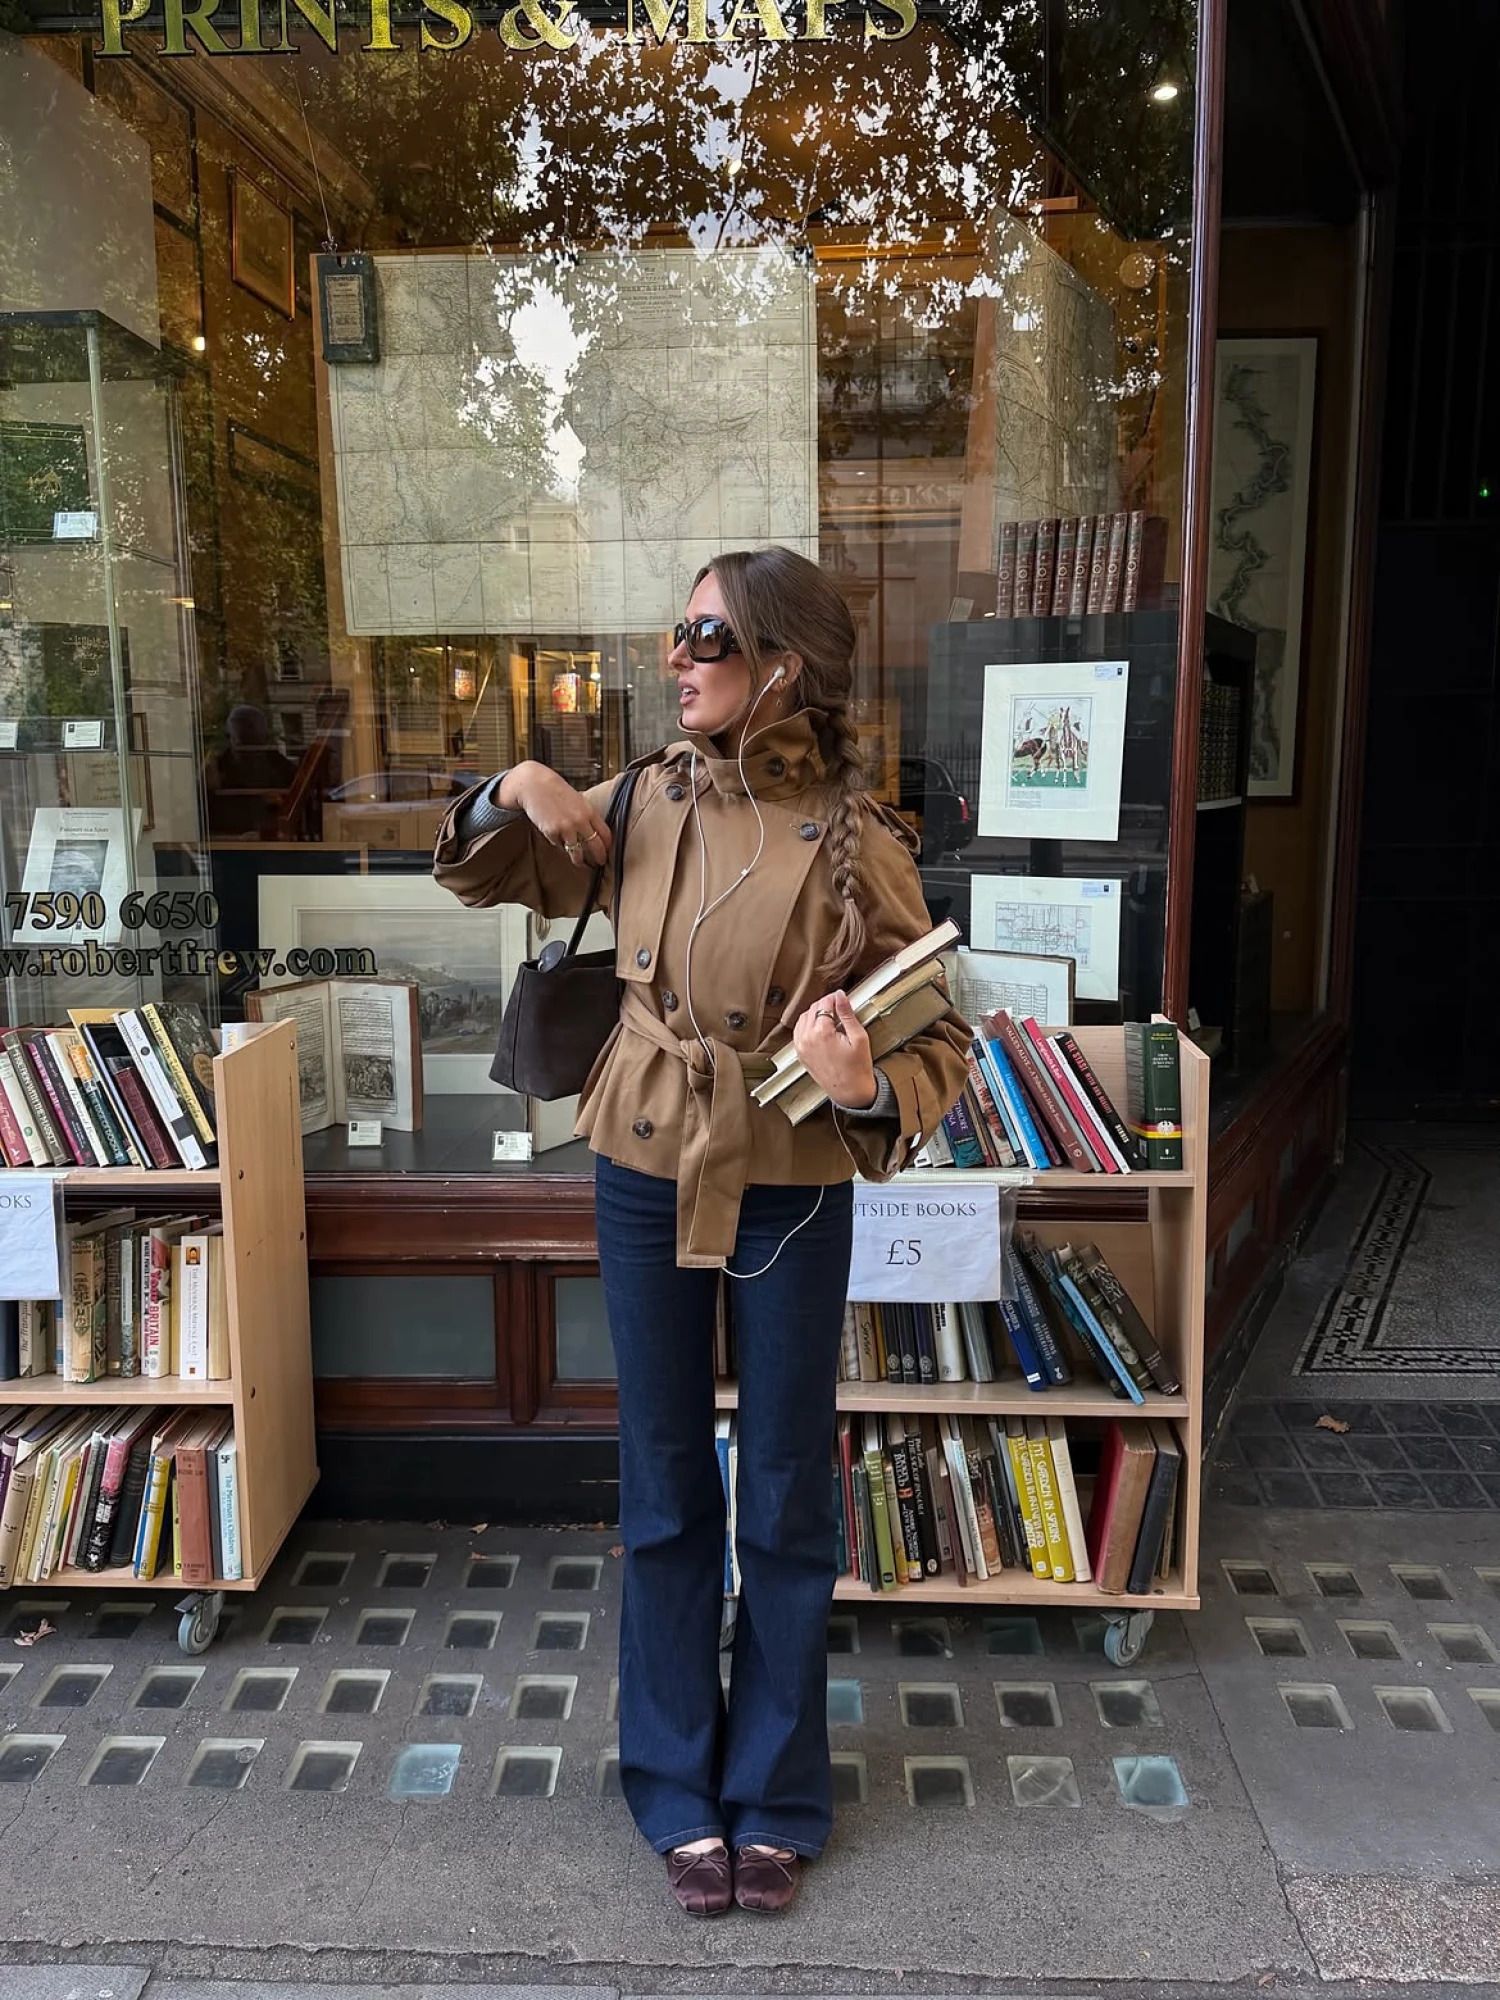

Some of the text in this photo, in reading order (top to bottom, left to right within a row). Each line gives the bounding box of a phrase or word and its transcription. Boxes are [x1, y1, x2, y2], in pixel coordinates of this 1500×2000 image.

[94, 0, 920, 58] PRINTS & MAPS
[5, 891, 220, 930] 7590 6650
[917, 1202, 976, 1216] BOOKS
[886, 1239, 922, 1265] £5
[148, 1305, 160, 1346] BRITAIN
[1019, 1451, 1034, 1485] GARDEN
[1034, 1459, 1053, 1498] GARDEN
[1042, 1498, 1055, 1511] IN
[1044, 1510, 1062, 1544] SPRING
